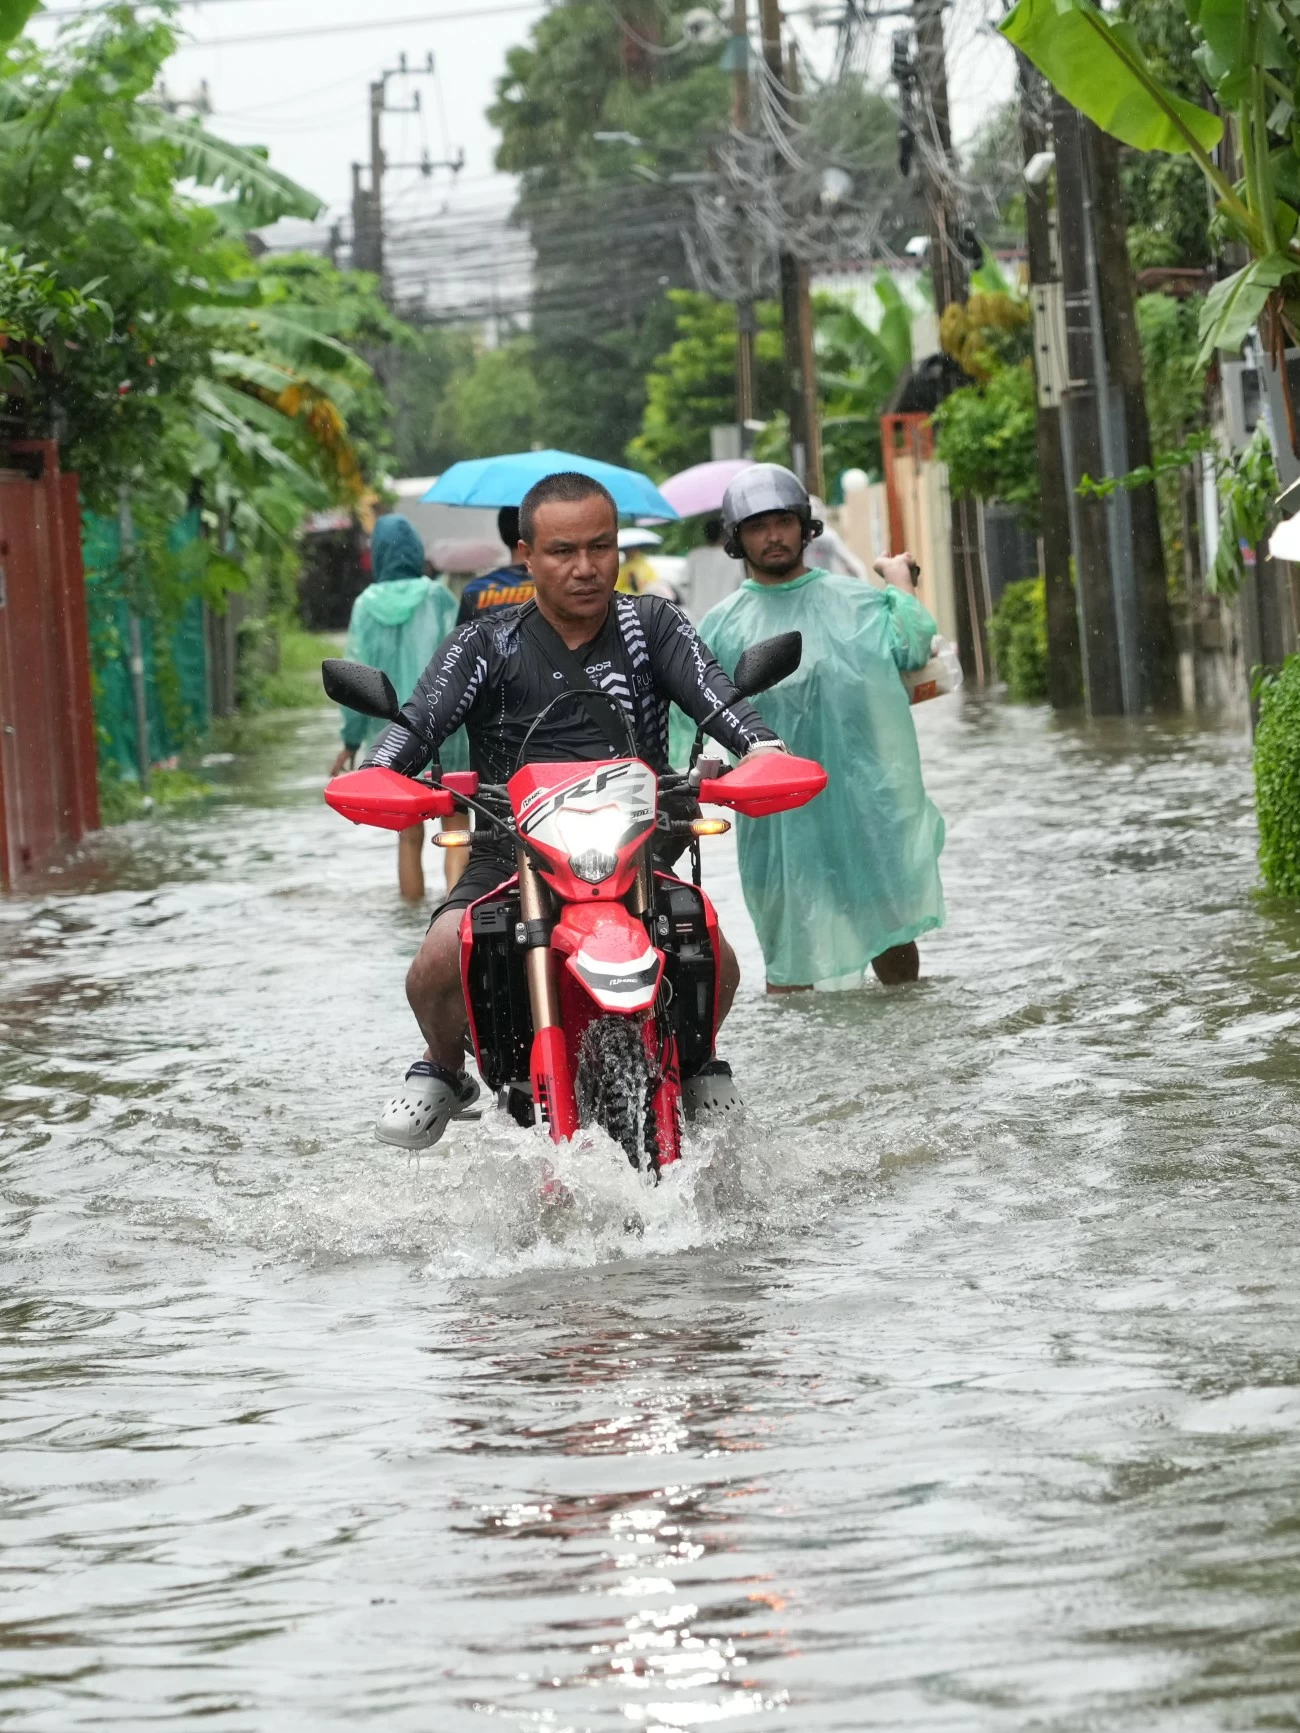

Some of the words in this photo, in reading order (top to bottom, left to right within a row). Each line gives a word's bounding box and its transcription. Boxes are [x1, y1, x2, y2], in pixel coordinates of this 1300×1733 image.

[441, 644, 464, 674] RUN
[703, 687, 740, 728] SPORTS
[519, 762, 632, 835] CRF
